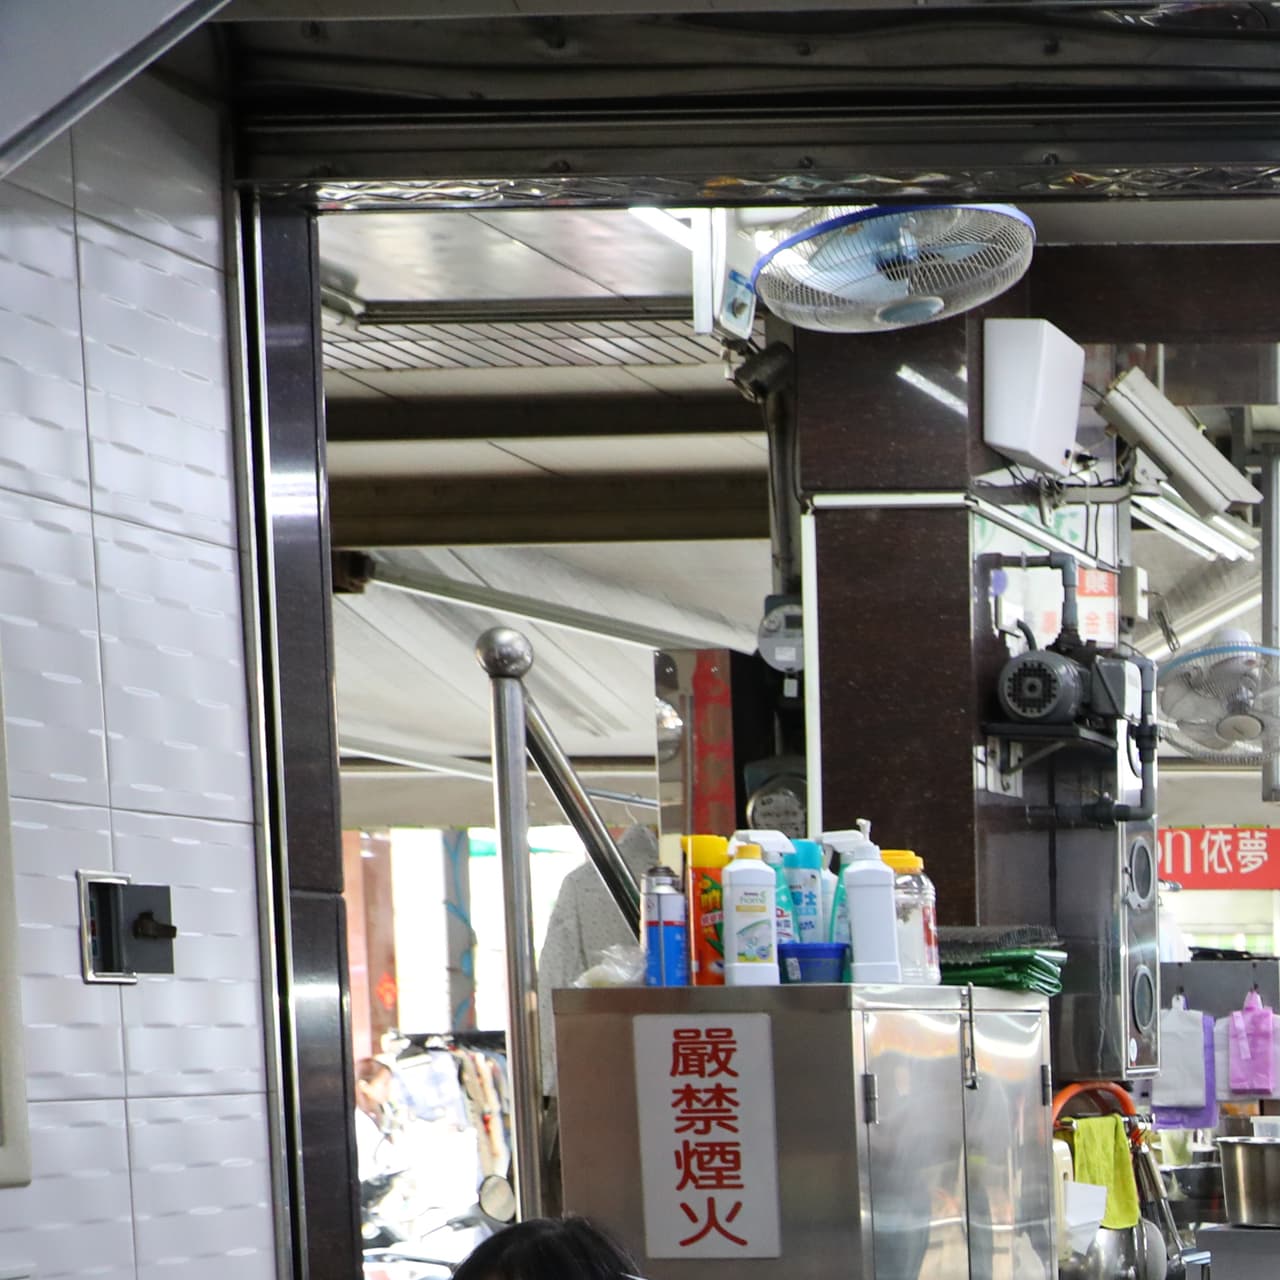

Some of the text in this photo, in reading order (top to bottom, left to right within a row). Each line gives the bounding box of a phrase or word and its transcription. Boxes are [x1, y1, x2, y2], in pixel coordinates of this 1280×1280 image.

[1200, 830, 1269, 874] 依夢
[670, 1028, 748, 1247] 嚴禁煙火
